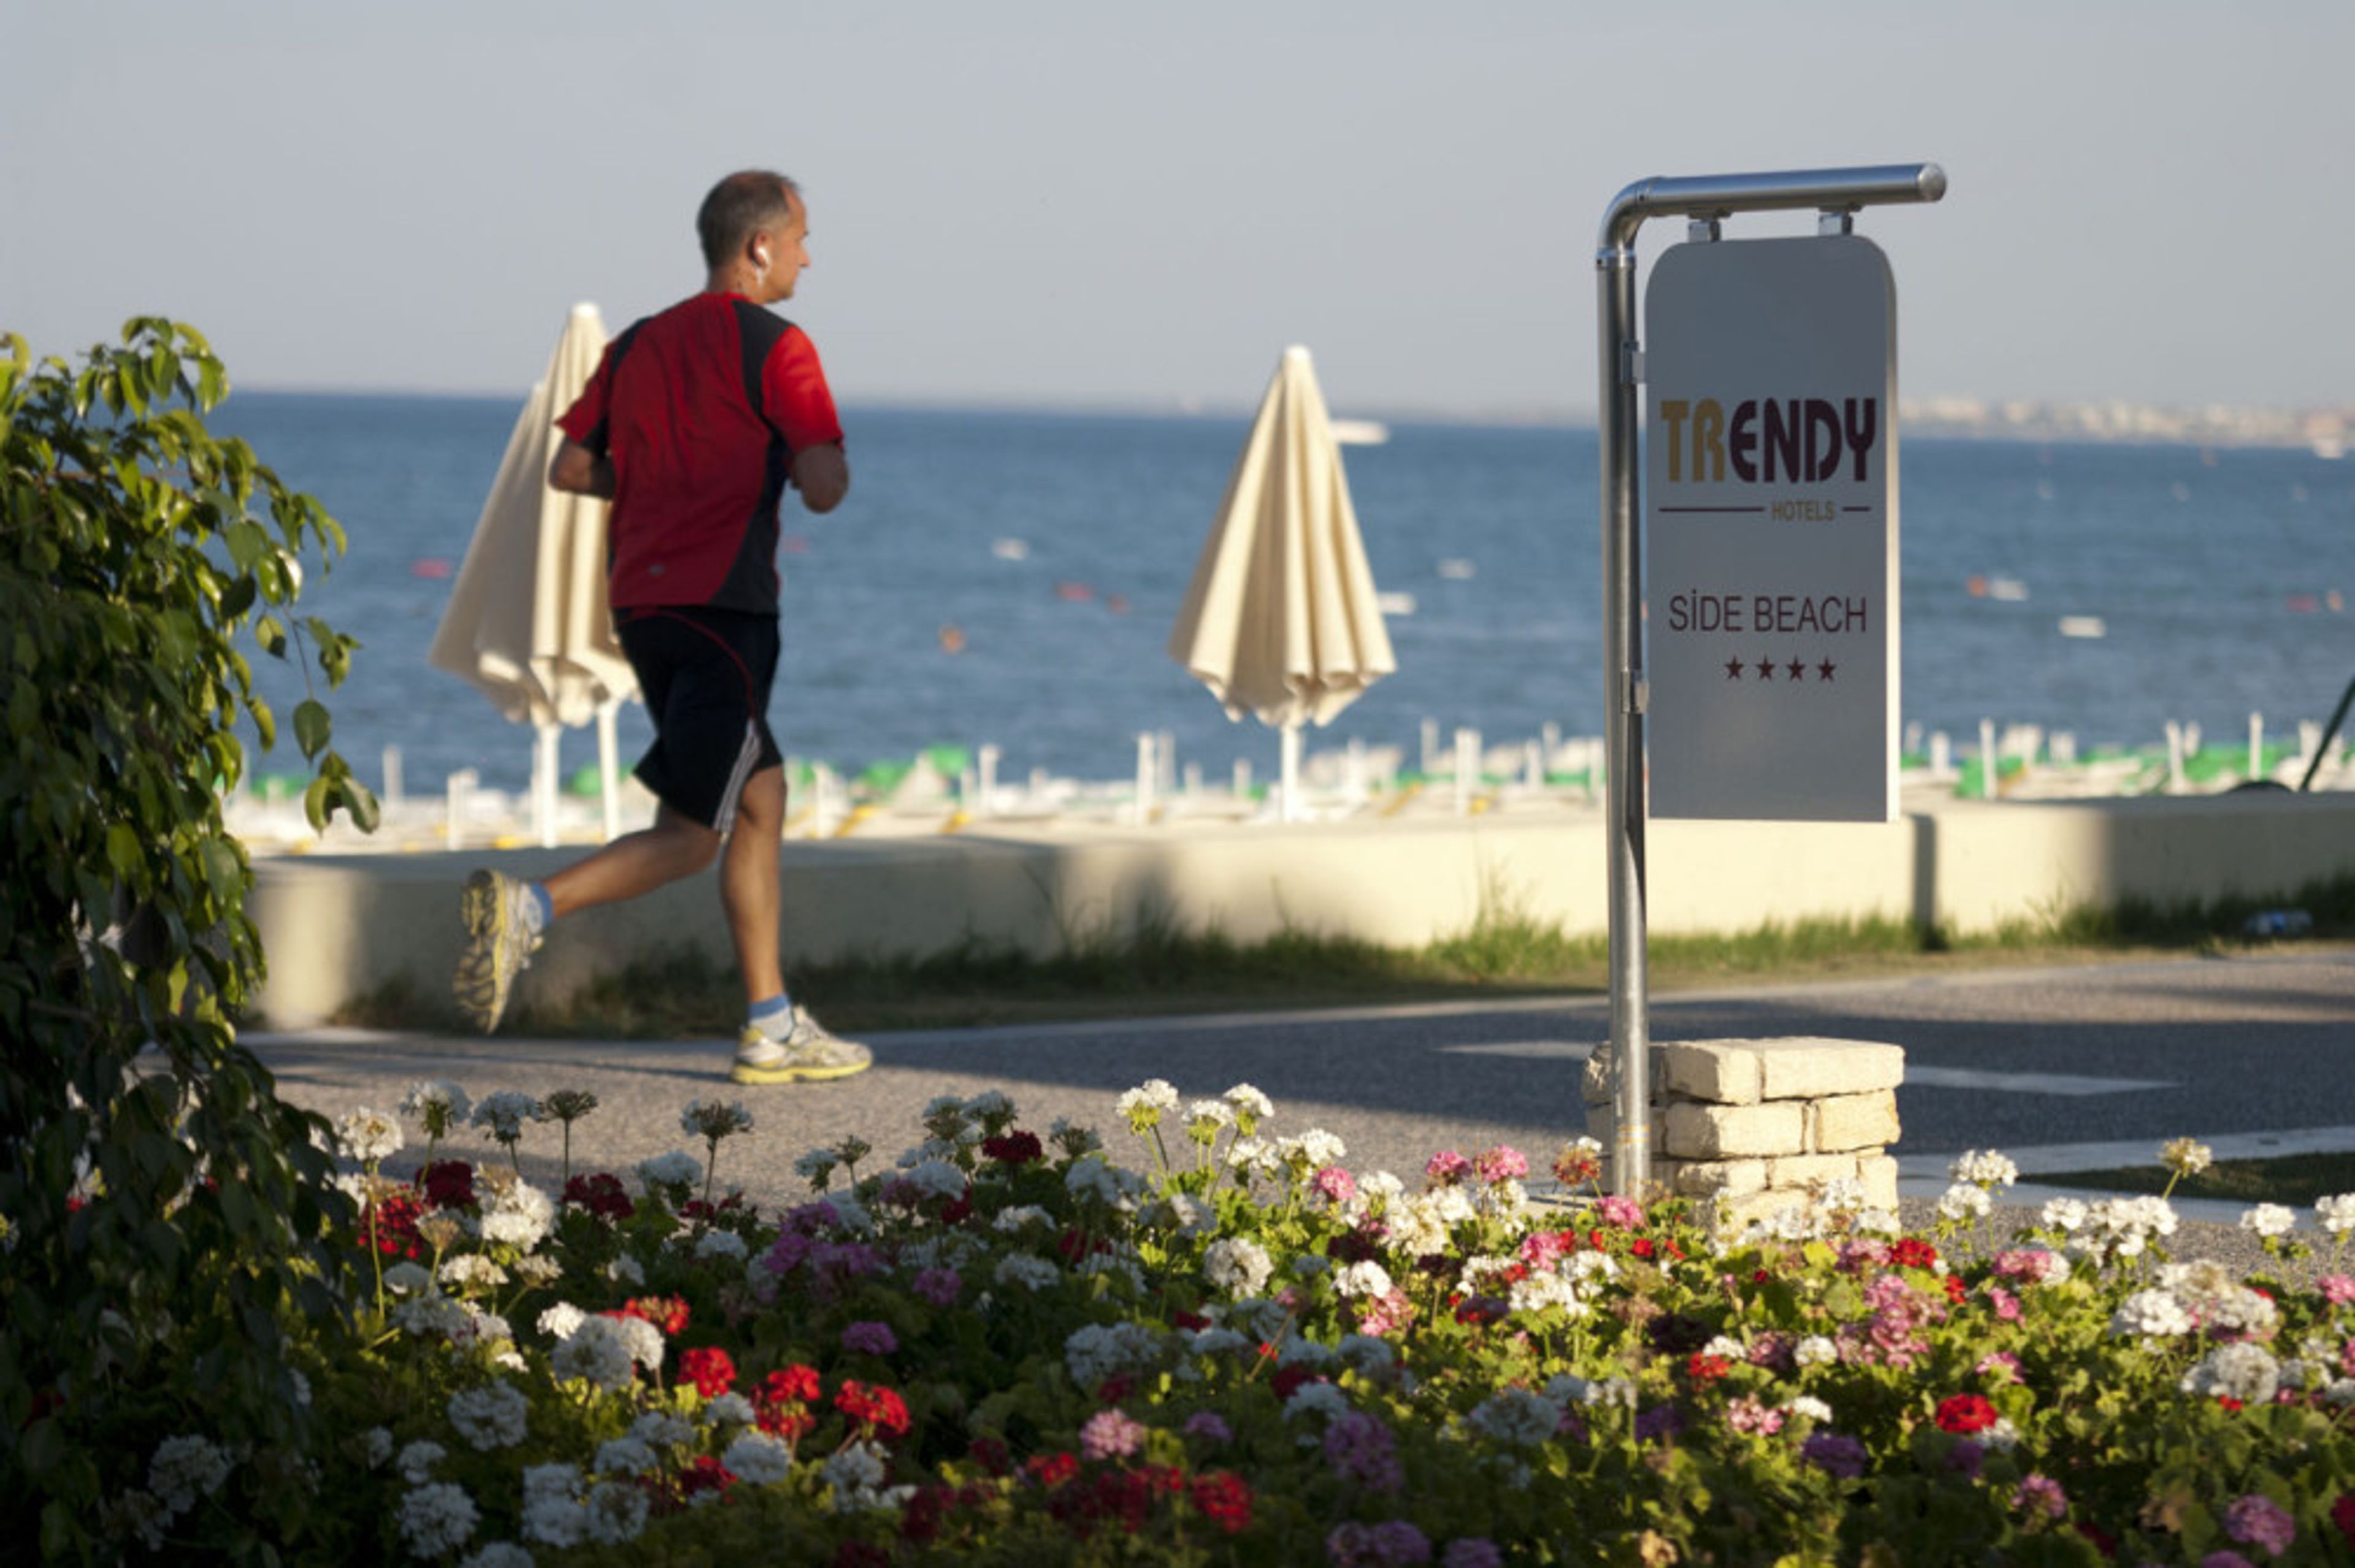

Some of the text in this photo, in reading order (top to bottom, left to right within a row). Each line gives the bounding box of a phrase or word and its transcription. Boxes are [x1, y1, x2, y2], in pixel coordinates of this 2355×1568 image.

[1661, 397, 1876, 483] TRENDY
[1771, 501, 1836, 522] HOTELS
[1754, 596, 1866, 633] BEACH
